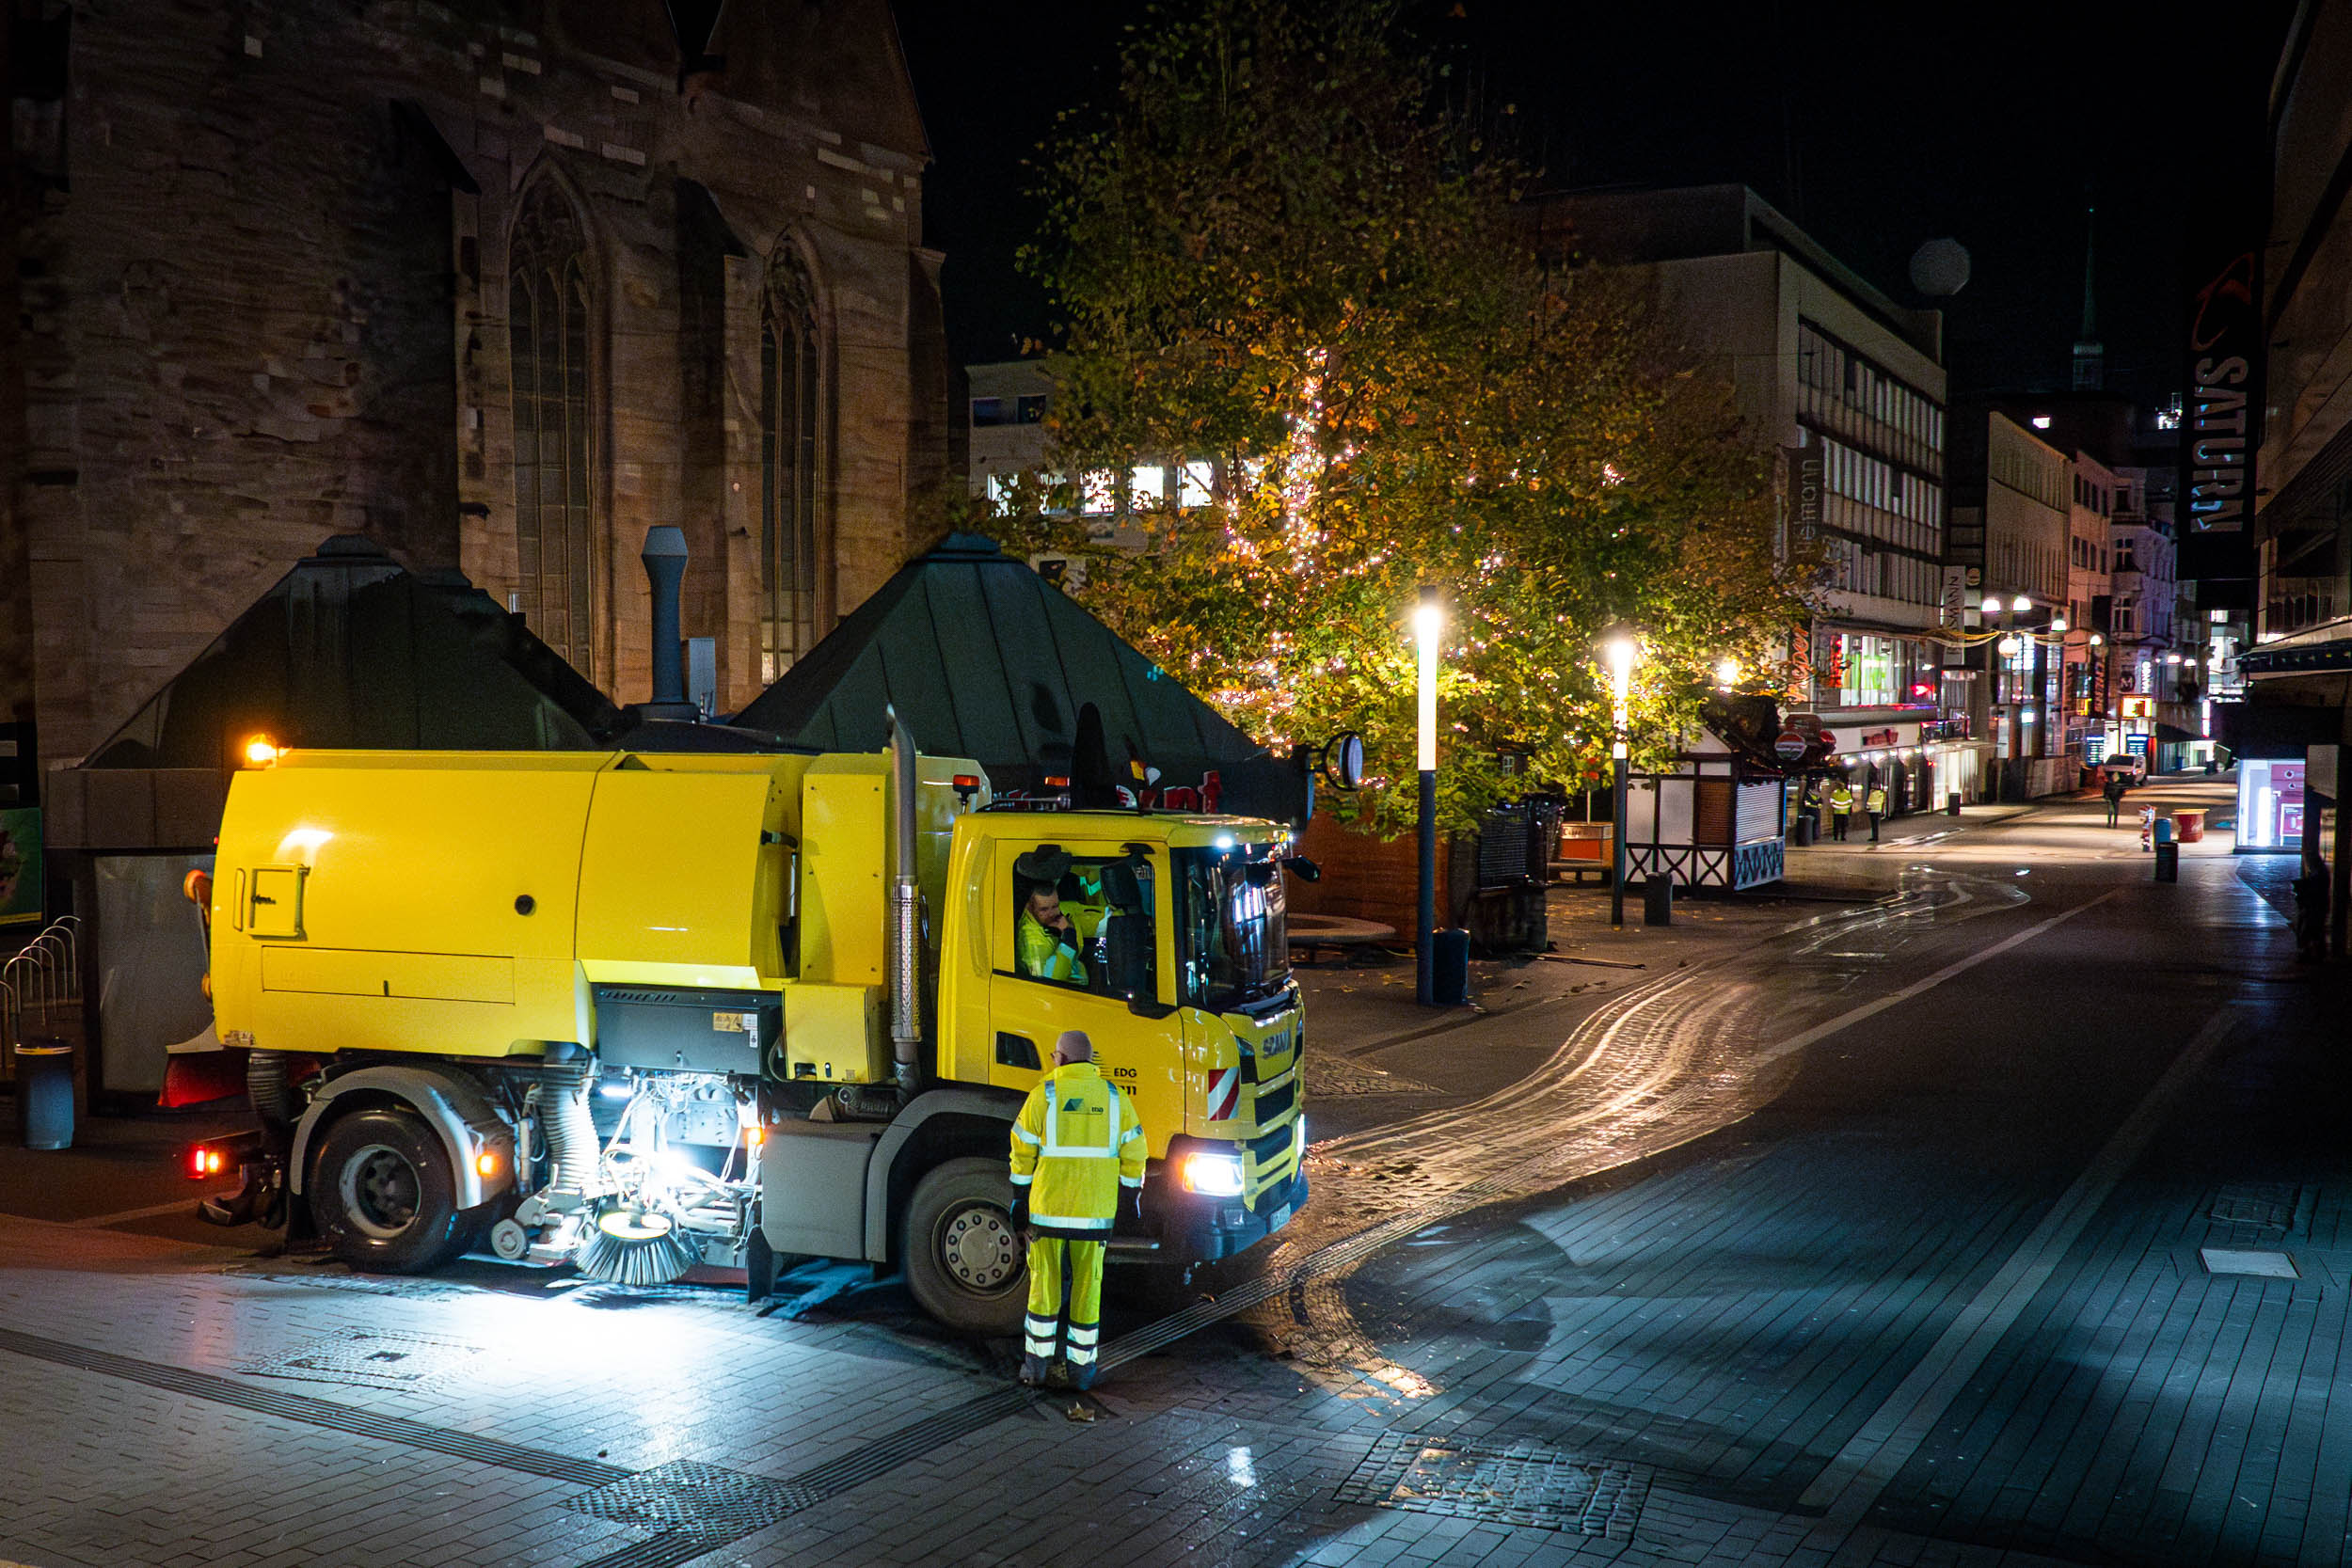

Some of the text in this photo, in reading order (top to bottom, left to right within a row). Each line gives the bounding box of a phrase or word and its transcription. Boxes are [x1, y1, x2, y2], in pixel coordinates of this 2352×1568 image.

[2190, 356, 2249, 532] SATURN
[2141, 661, 2152, 694] MANGO
[1113, 1068, 1137, 1078] EDG
